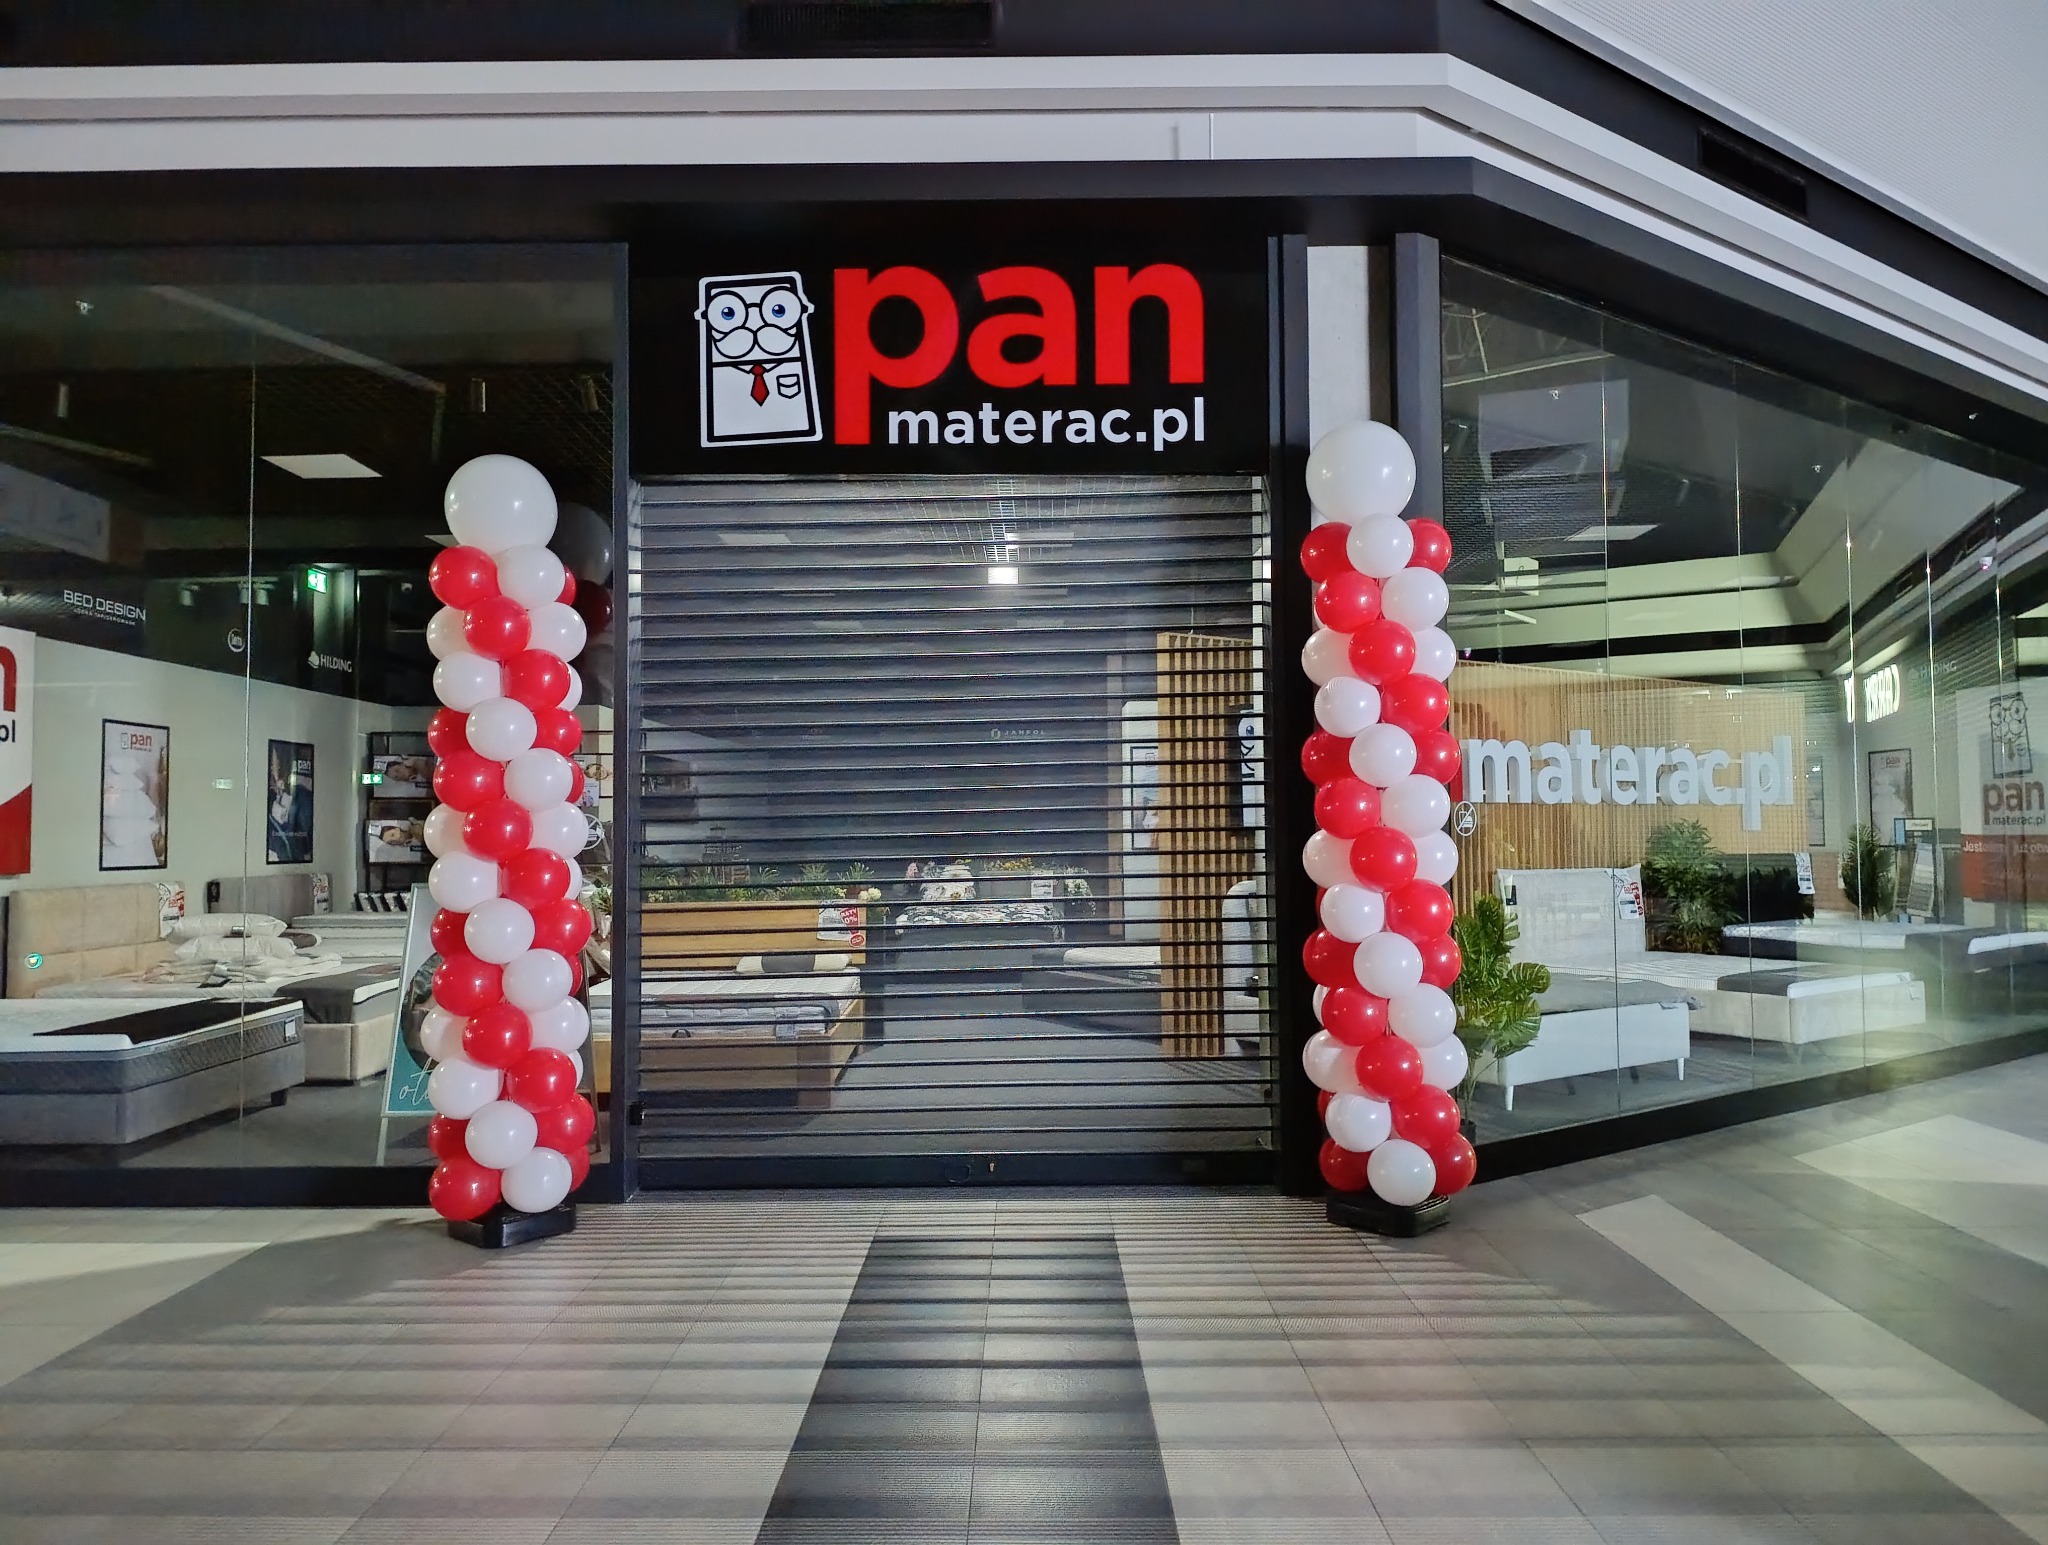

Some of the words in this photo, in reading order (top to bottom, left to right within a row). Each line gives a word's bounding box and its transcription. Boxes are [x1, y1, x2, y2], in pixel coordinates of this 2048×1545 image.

[834, 263, 1204, 445] pan
[888, 397, 1205, 452] materac.pl
[64, 589, 94, 608] BED
[96, 598, 146, 621] DESIGN
[320, 654, 352, 673] HILDING
[130, 733, 152, 750] pan
[297, 760, 312, 773] pan
[1459, 729, 1794, 831] materac.pl
[1983, 781, 2045, 826] pan
[1993, 813, 2047, 827] materac.pl
